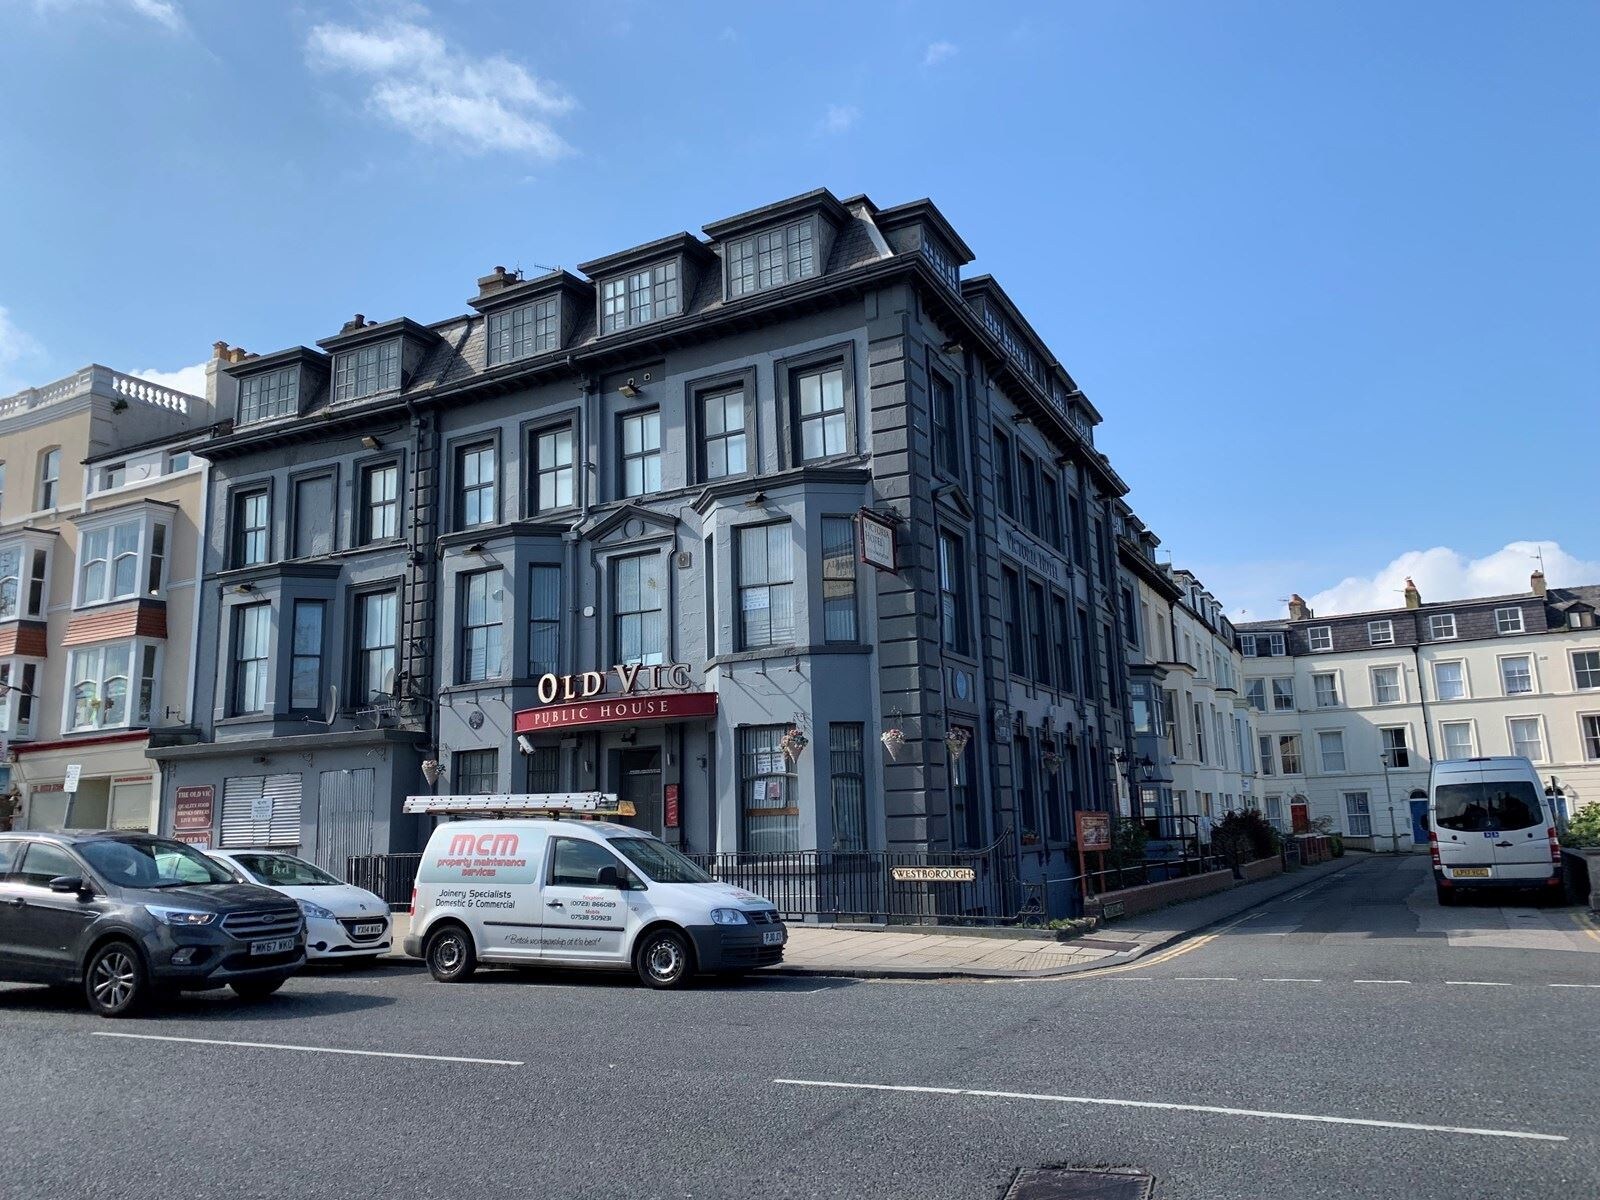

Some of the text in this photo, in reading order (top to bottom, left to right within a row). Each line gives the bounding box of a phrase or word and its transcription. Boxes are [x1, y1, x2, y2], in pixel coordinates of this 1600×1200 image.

[538, 663, 692, 704] OLD VIC
[535, 700, 668, 725] PUBLIC HOUSE
[448, 834, 519, 856] mcm
[437, 858, 527, 868] property maintenance
[461, 868, 496, 877] services
[895, 869, 971, 879] WESTBOROUGH
[439, 889, 512, 899] Joinery Specialists
[435, 899, 516, 909] Domestic & Commercial
